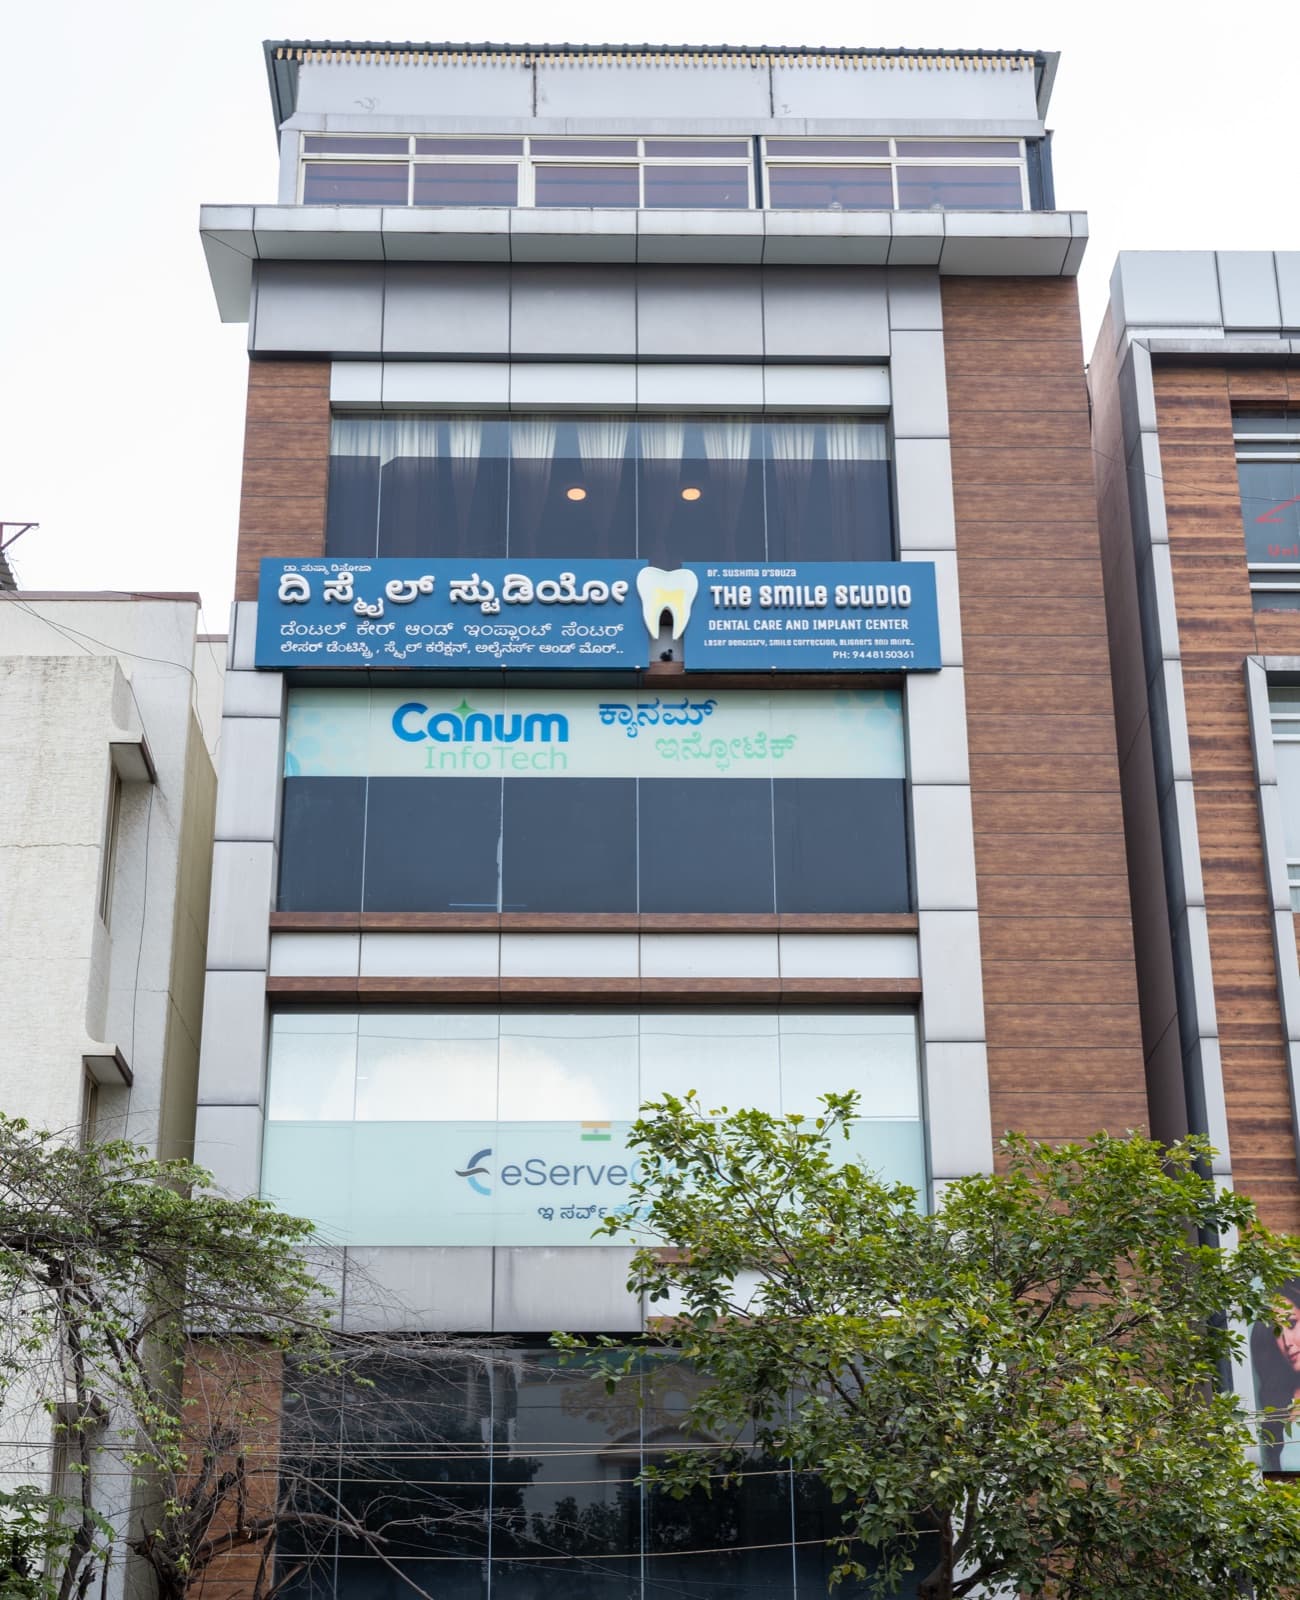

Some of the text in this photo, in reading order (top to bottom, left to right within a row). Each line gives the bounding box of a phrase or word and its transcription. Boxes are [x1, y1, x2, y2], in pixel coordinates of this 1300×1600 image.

[278, 572, 311, 604] ದಿ
[449, 572, 629, 615] ಸ್ಟುಡಿಯೋ
[280, 620, 625, 641] ಡೆಂಟಲ್ ಕೇರ್ ಆಂಡ್ ಇಂಪ್ಲಾಂಟ್ ಸೆಂಟರ್
[708, 618, 909, 631] DENTAL CARE AND IMPLANT CENTER
[280, 641, 323, 653] ಲೇಸರ್
[832, 650, 915, 659] PH: 9448150361
[392, 702, 569, 743] Canum
[598, 697, 719, 738] ಕ್ಯಾನಮ್
[424, 745, 568, 770] InfoTech
